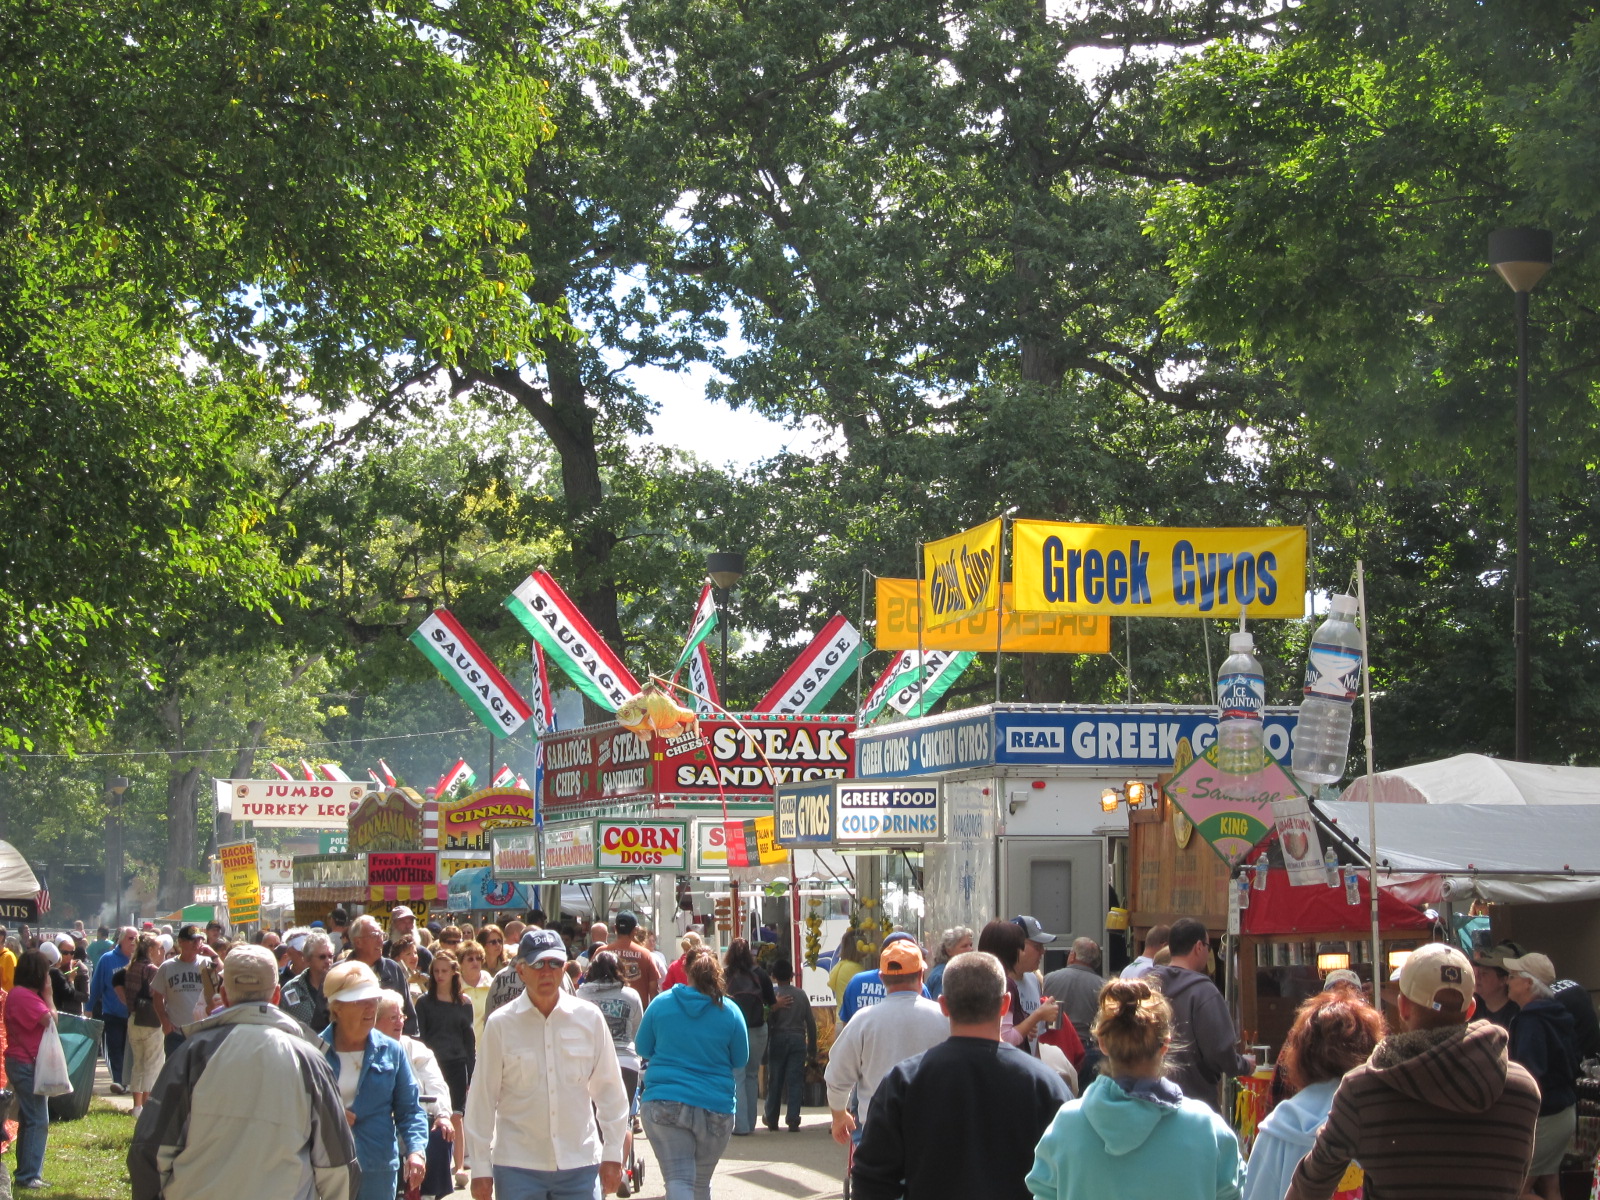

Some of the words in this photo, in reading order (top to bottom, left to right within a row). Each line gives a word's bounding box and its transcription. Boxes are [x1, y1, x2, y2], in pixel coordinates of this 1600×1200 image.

[1042, 535, 1152, 605] Greek
[1172, 540, 1278, 612] Gyros
[531, 595, 626, 706] SAUSAGE
[431, 628, 516, 727] SAUSAGE
[780, 638, 850, 713] AUSAGE
[1233, 685, 1246, 698] ICE
[1220, 697, 1262, 709] MOUNTAIN
[611, 732, 650, 765] STEAK
[714, 728, 848, 761] STEAK
[861, 742, 883, 776] GREEK
[884, 736, 910, 773] GYROS
[920, 726, 956, 769] CHICKEN
[957, 722, 989, 764] GYROS
[1011, 731, 1060, 748] REAL
[1071, 721, 1181, 760] GREEK
[547, 738, 593, 770] SARATOGA
[555, 770, 581, 798] CHIPS
[602, 767, 645, 791] SANDWICH
[677, 765, 846, 787] SANDWICH
[266, 785, 334, 798] JUMBO
[842, 791, 890, 807] GREEK
[892, 791, 936, 806] FOOD
[242, 803, 309, 816] TURKEY
[317, 804, 351, 817] LEG
[781, 796, 795, 815] CHICKEN
[798, 794, 831, 837] GYROS
[357, 809, 414, 847] CINNAMON
[782, 819, 795, 836] GYROS
[841, 814, 880, 834] COLD
[883, 814, 937, 834] DRINKS
[1220, 816, 1249, 836] KING
[604, 827, 680, 853] CORN
[221, 844, 252, 859] BACON
[372, 856, 401, 866] Fresh
[405, 856, 431, 866] Fruit
[499, 849, 531, 870] SAUSAGE
[621, 850, 663, 865] DOGS
[223, 855, 254, 869] RINDS
[269, 859, 294, 869] STU
[370, 867, 434, 883] SMOOTHIES
[168, 974, 180, 989] US
[181, 971, 203, 984] ARM
[810, 995, 832, 1003] Fish
